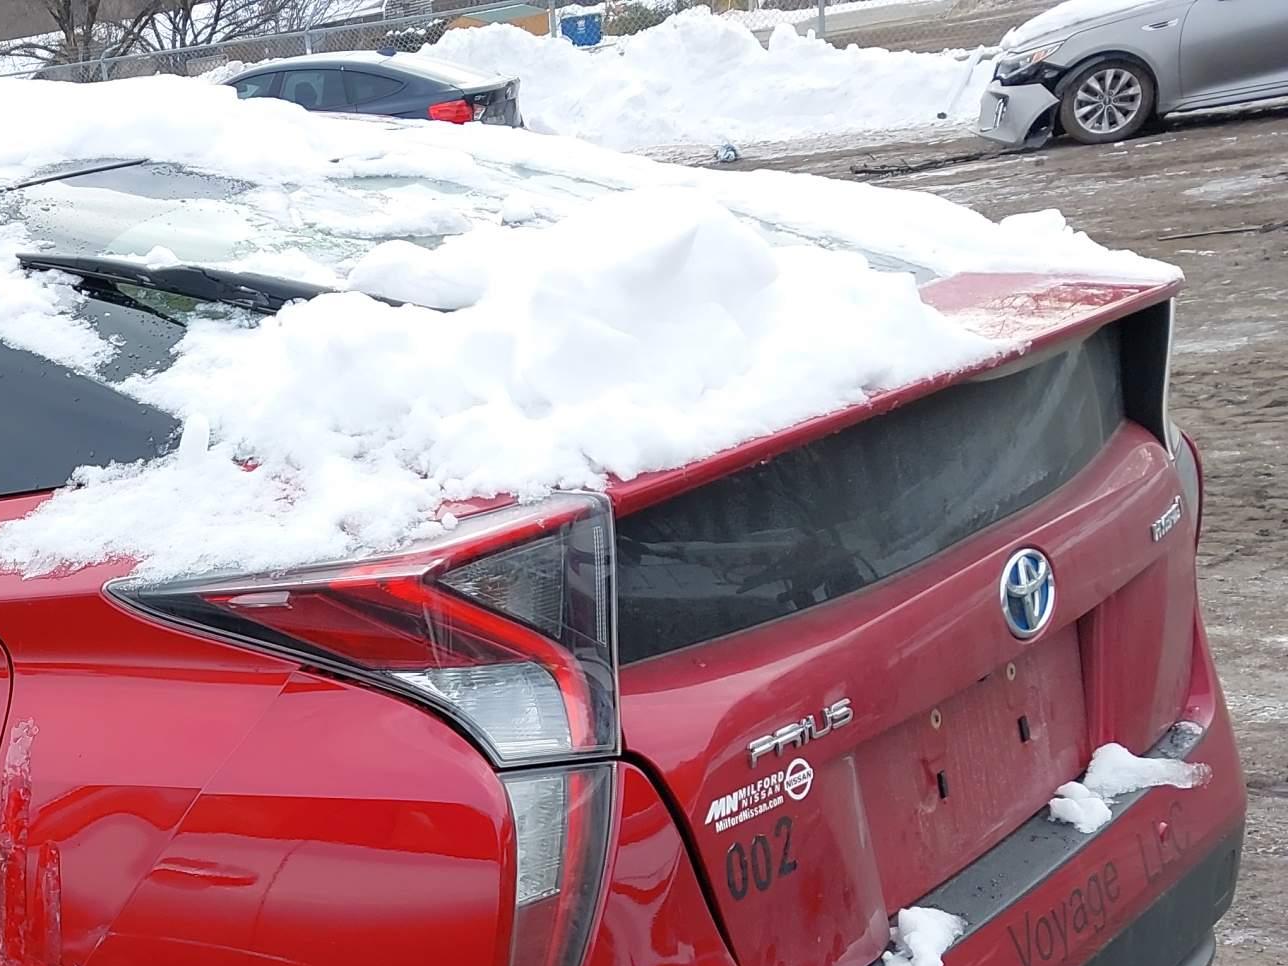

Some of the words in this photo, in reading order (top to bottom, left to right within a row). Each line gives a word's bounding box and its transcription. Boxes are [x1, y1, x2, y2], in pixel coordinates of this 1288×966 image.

[748, 698, 854, 769] PRIUS
[737, 771, 785, 799] MILFORD
[741, 785, 781, 808] NISSAN
[785, 769, 813, 789] NISSAN
[705, 788, 740, 825] MN
[715, 796, 784, 833] MilfordNissan.com
[726, 815, 798, 901] 002
[1136, 800, 1190, 886] LLC
